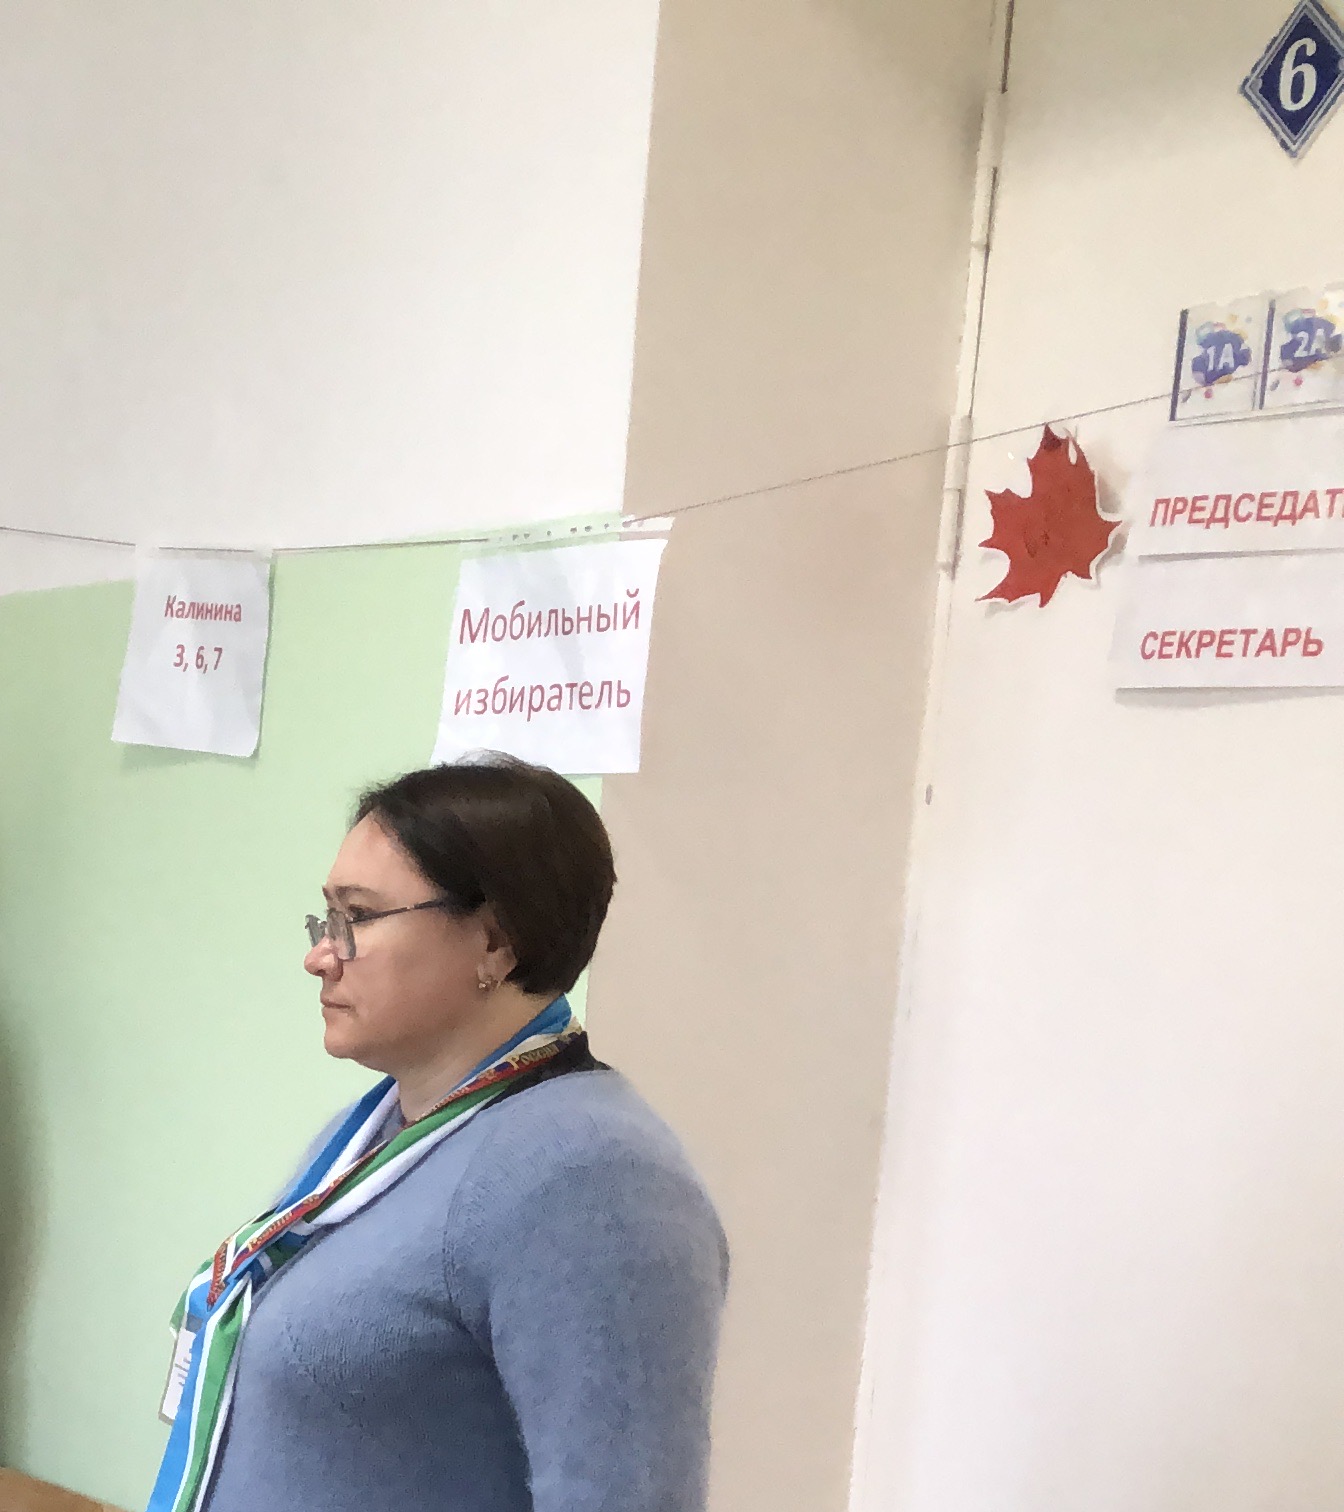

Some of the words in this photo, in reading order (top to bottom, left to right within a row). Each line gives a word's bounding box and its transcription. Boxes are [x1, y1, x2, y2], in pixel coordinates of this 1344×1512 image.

[1279, 37, 1317, 112] 6
[1149, 488, 1344, 530] ПРЕДСЕДАТ
[164, 594, 242, 622] Калинина
[459, 588, 640, 644] Мобильный
[173, 643, 189, 672] 3,
[1140, 626, 1324, 660] СЕКРЕТАРЬ
[454, 674, 631, 722] избиратель
